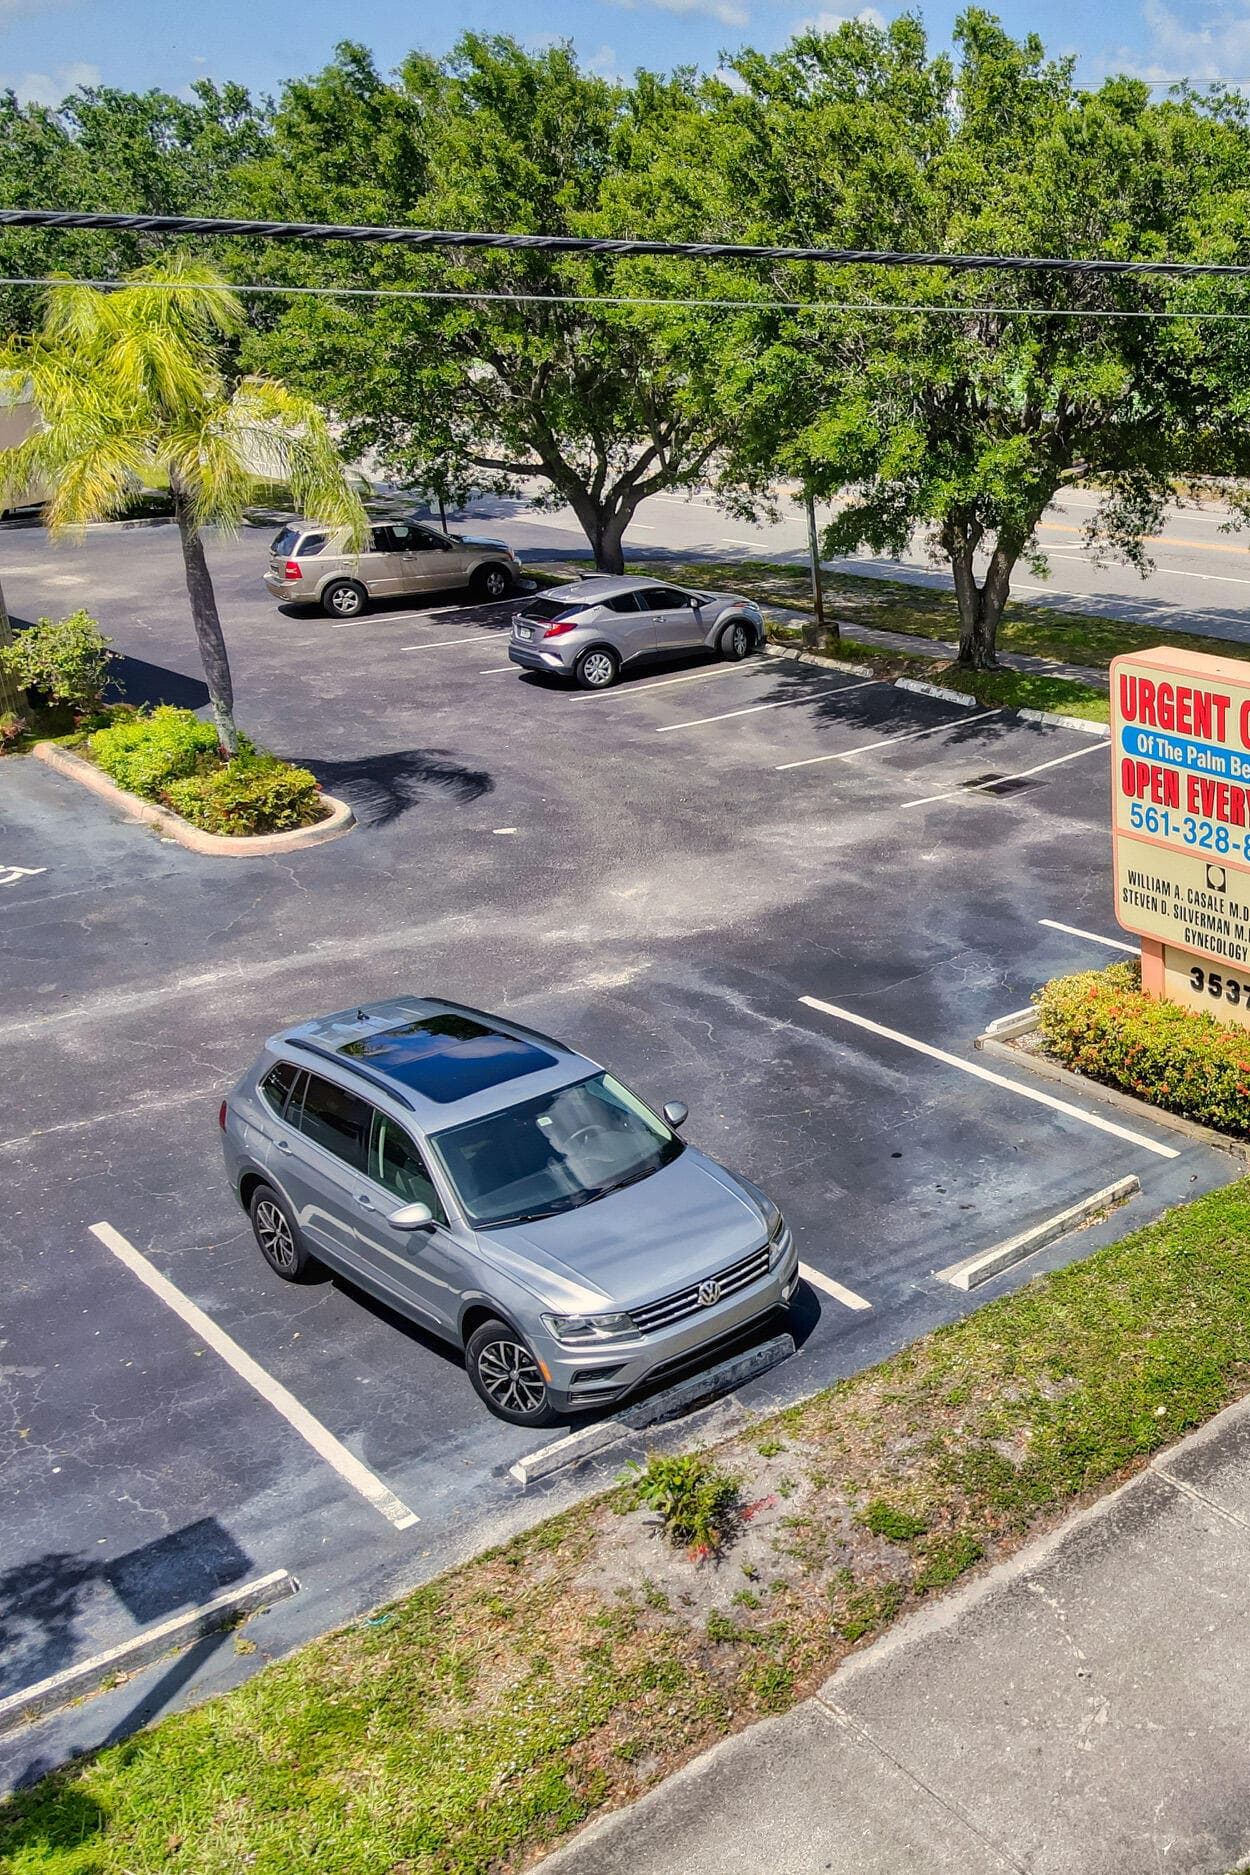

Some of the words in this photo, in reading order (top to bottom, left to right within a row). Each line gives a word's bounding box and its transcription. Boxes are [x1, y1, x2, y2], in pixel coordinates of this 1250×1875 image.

[1120, 674, 1230, 743] URGENT
[1137, 734, 1154, 753] Of
[1156, 738, 1182, 761] The
[1187, 746, 1225, 773] Palm
[1122, 758, 1179, 809] OPEN
[1123, 888, 1157, 912] STEVEN
[1161, 900, 1170, 916] D.
[1174, 904, 1230, 936] SILVERMAN
[1128, 870, 1171, 894] WILLIAM
[1174, 883, 1184, 901] A.
[1187, 889, 1224, 914] CASALE
[1185, 928, 1248, 962] GYNECOLOGY
